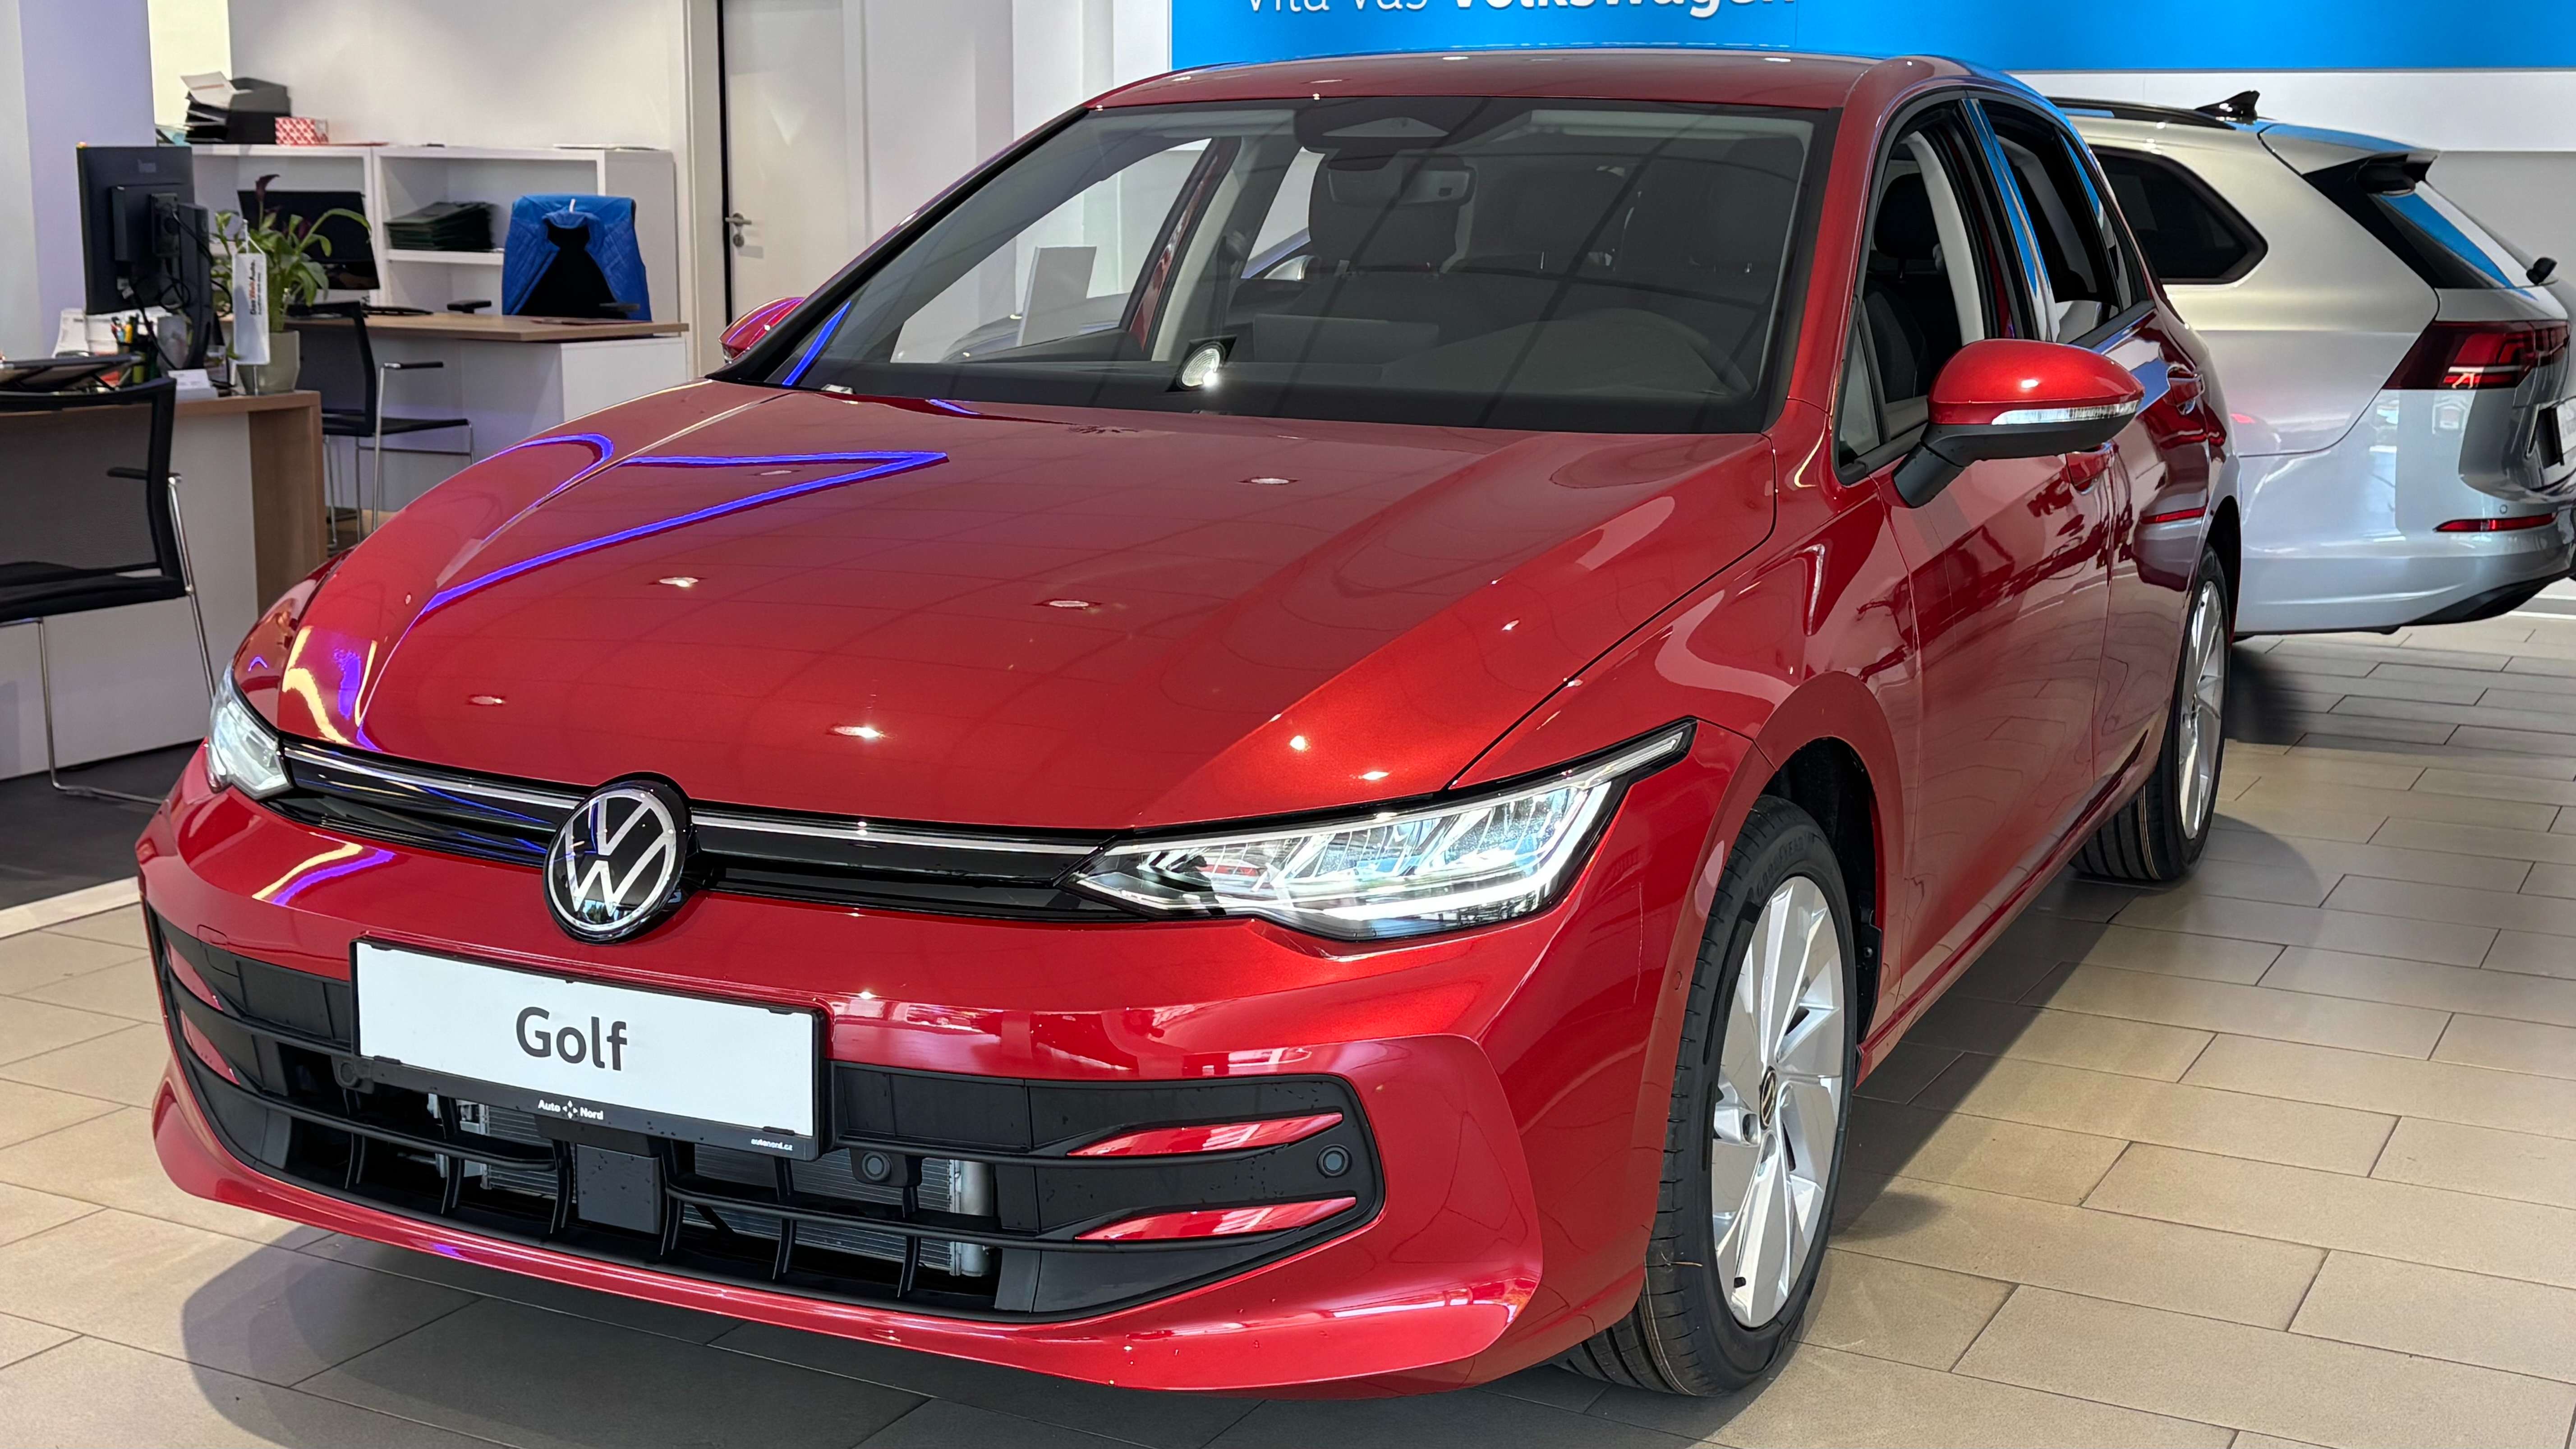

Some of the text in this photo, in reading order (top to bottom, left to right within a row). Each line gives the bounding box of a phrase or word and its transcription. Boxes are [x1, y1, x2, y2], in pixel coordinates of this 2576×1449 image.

[555, 790, 676, 922] VW
[516, 1006, 627, 1071] Golf
[538, 1099, 604, 1120] Auto Nord
